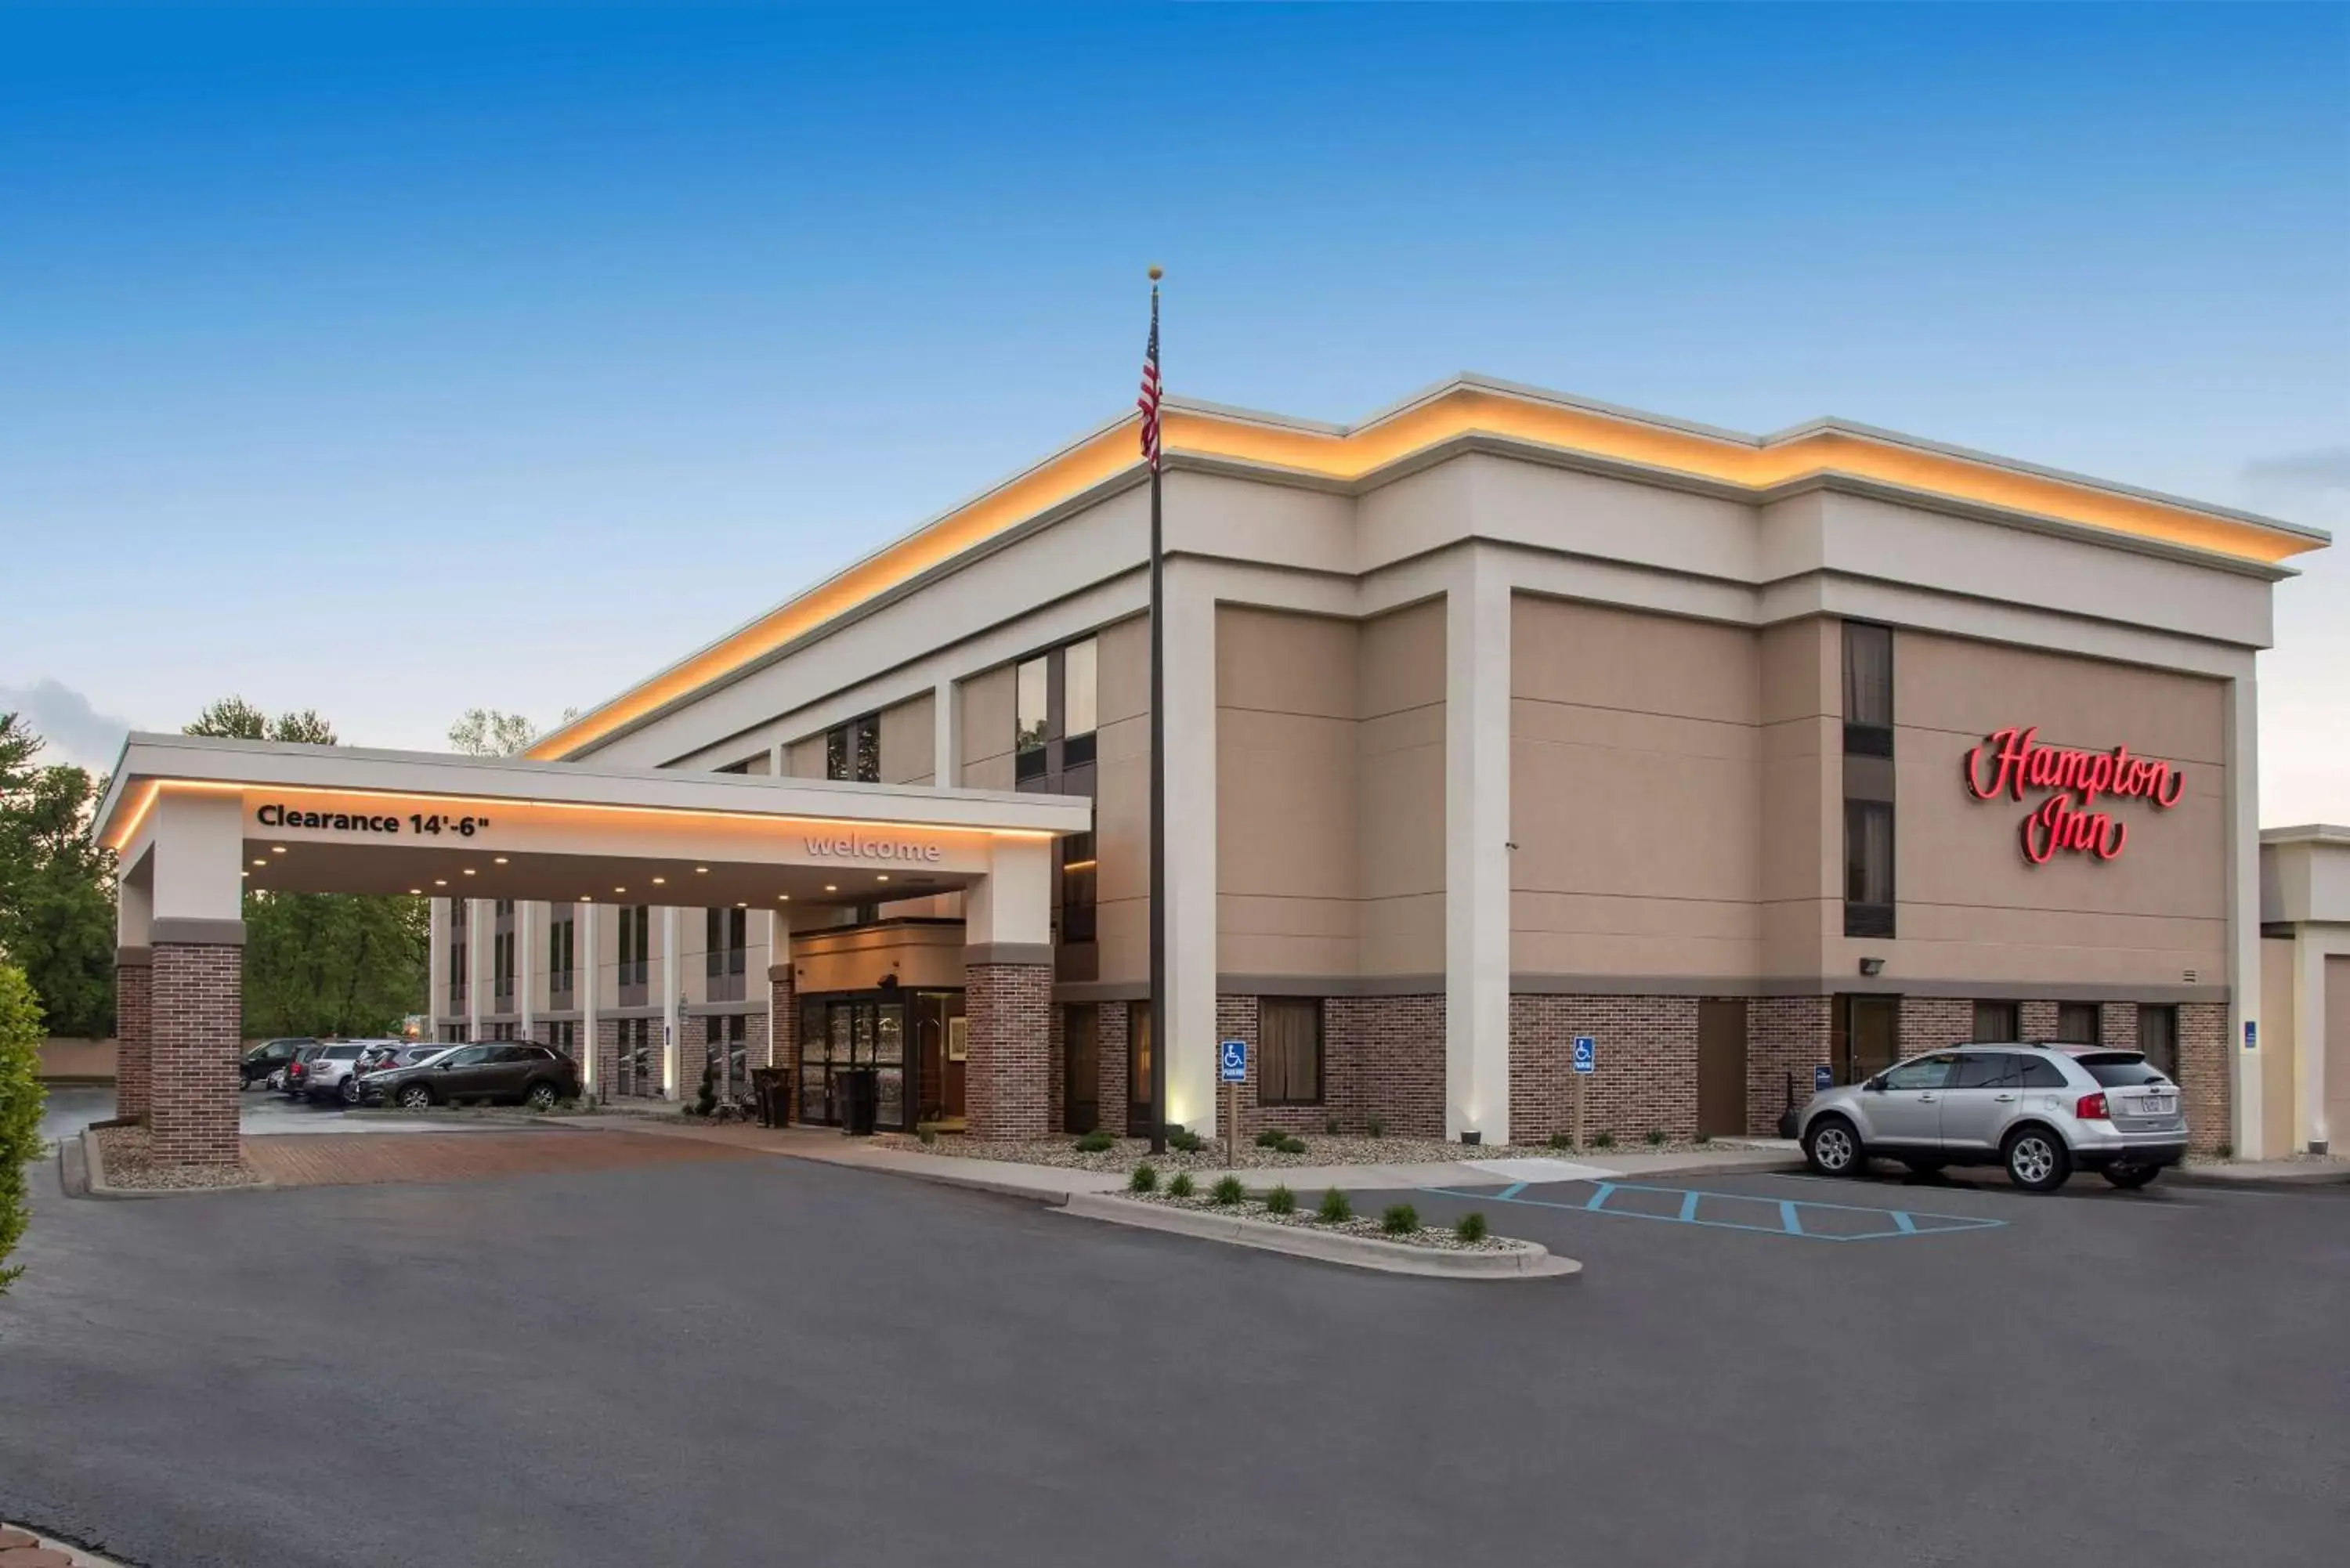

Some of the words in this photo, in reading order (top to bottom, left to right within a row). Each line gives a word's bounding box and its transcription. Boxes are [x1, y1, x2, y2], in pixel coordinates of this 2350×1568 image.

[1965, 726, 2186, 808] Hampton
[257, 804, 400, 833] Clearance
[410, 814, 490, 836] 14'-6"
[2020, 793, 2127, 864] Inn
[804, 832, 941, 862] welcome
